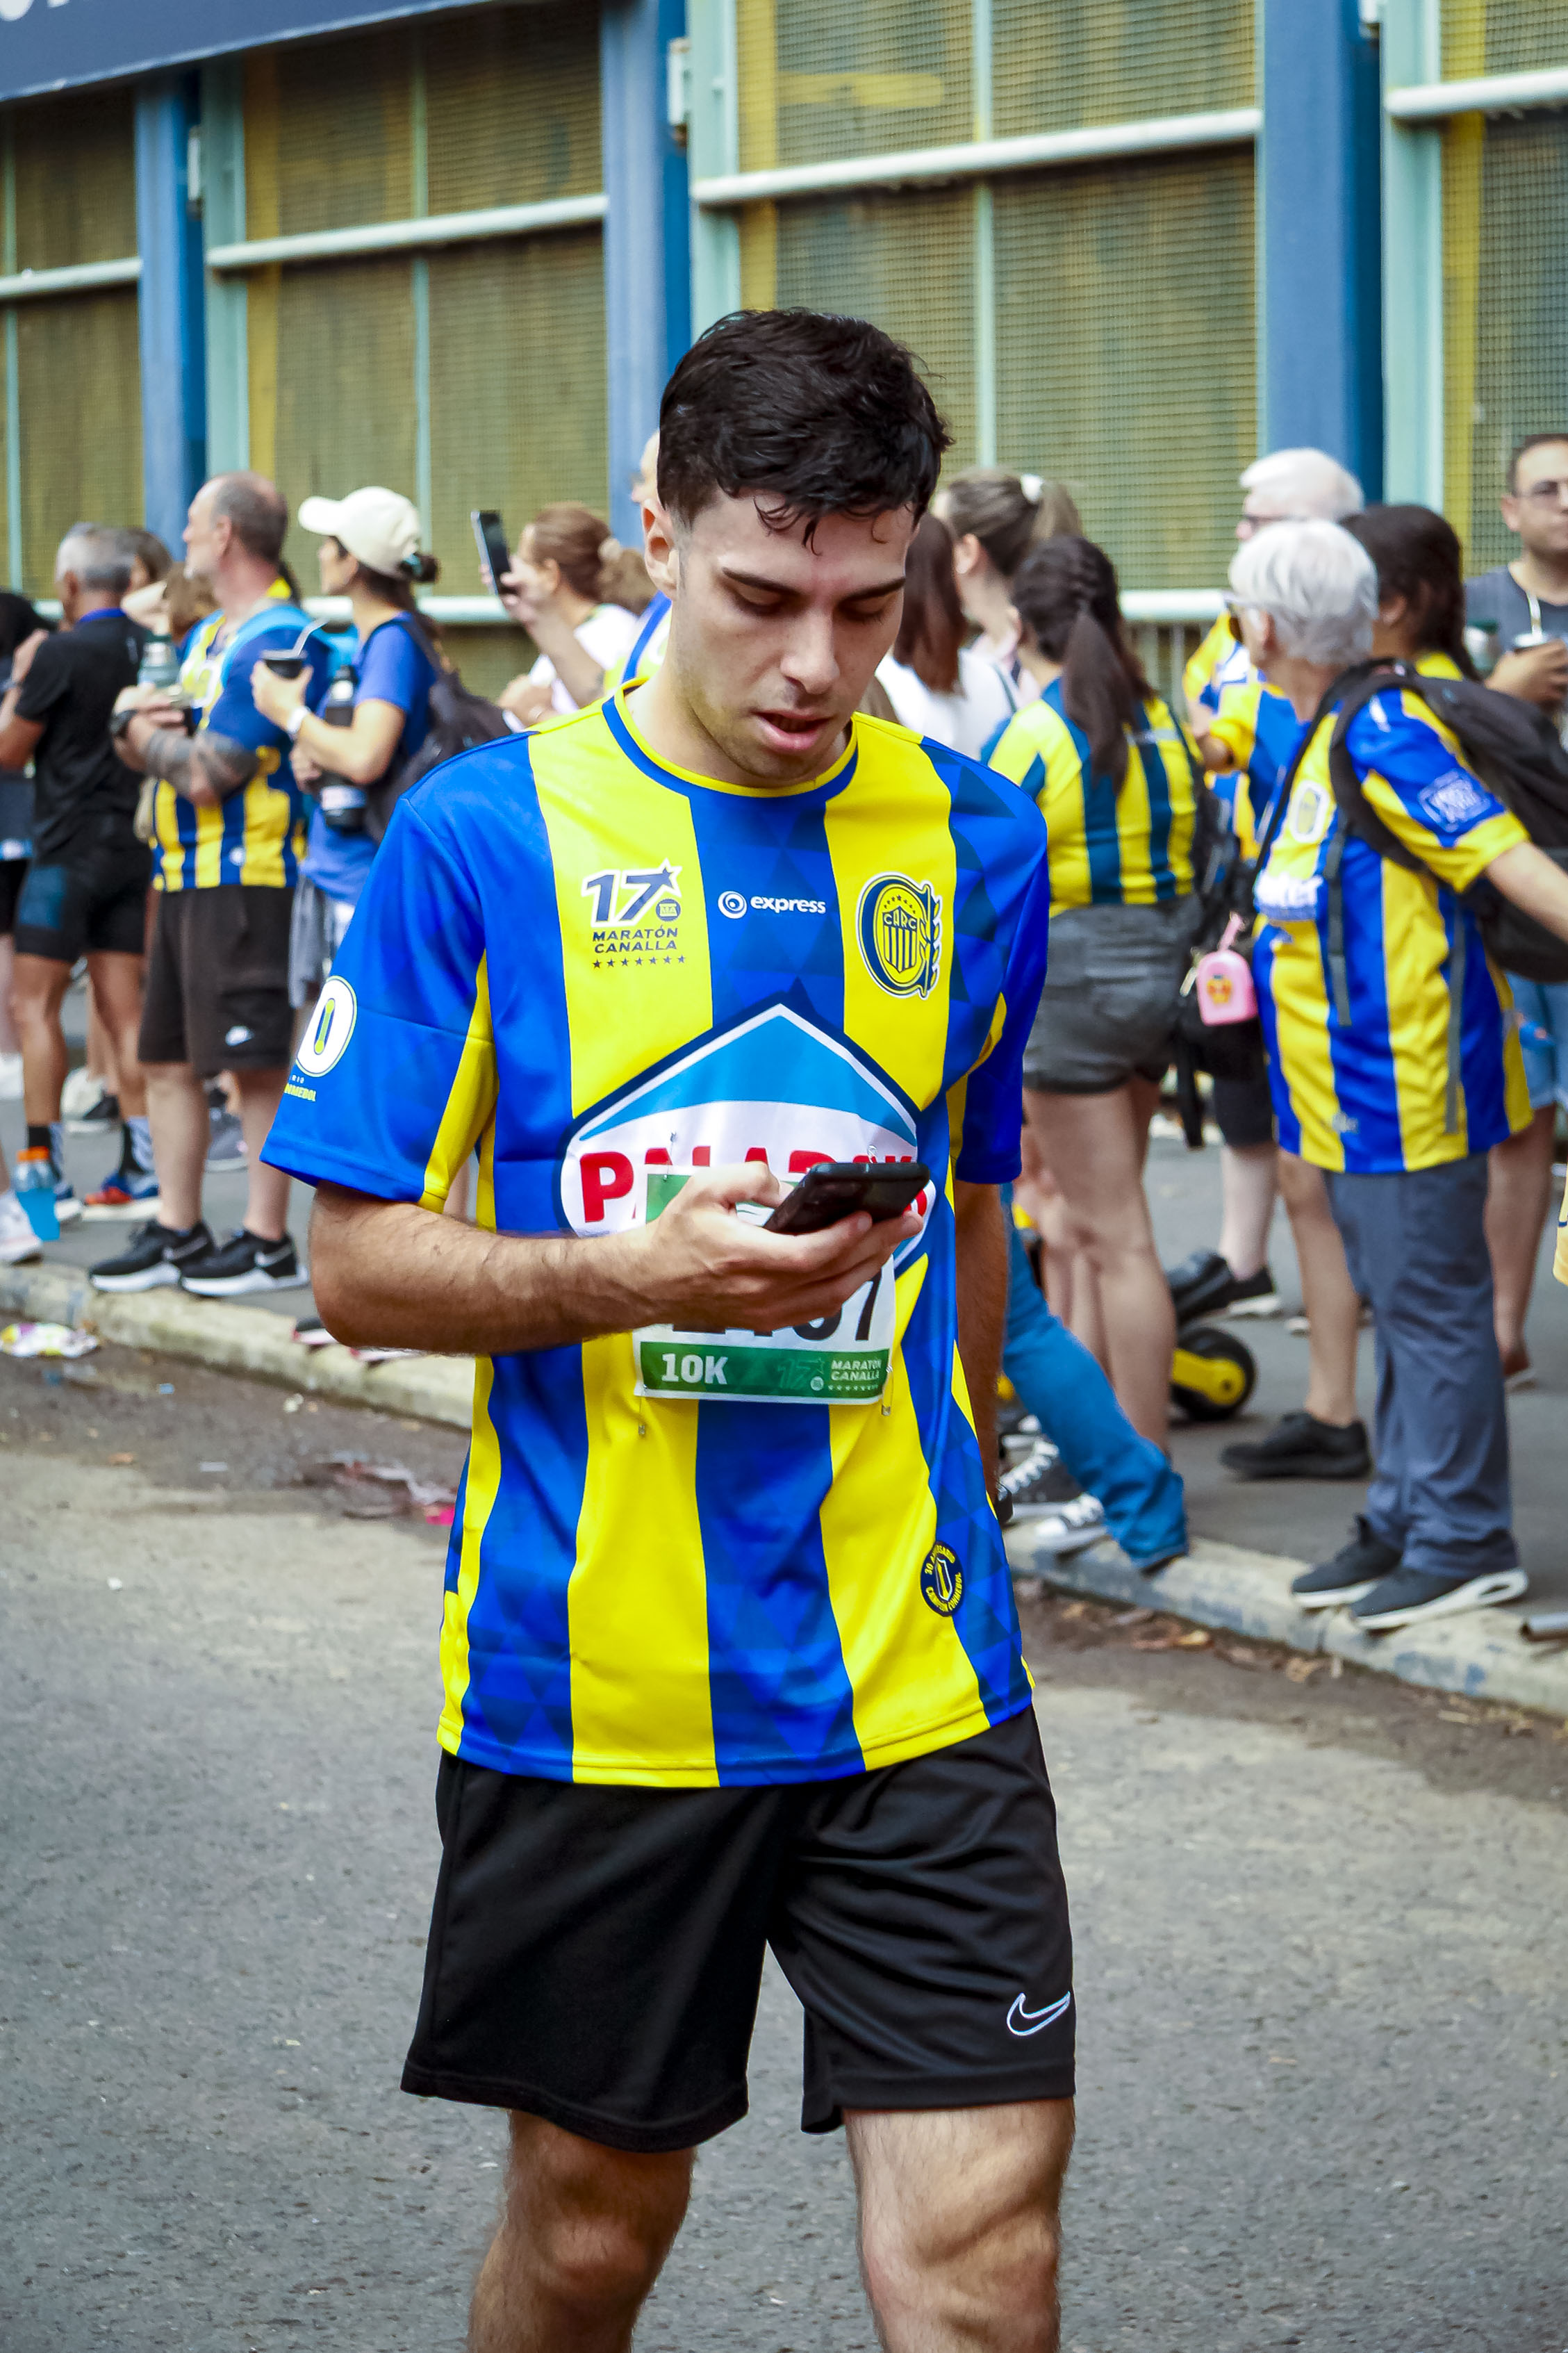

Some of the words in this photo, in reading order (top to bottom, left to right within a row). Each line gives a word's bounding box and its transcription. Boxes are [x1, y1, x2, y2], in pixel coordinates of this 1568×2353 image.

[584, 864, 675, 925] 17
[750, 894, 827, 914] express
[883, 908, 917, 930] CARC
[593, 925, 678, 942] MARATÓN
[594, 940, 677, 953] CANALLA
[661, 1353, 729, 1385] 10K
